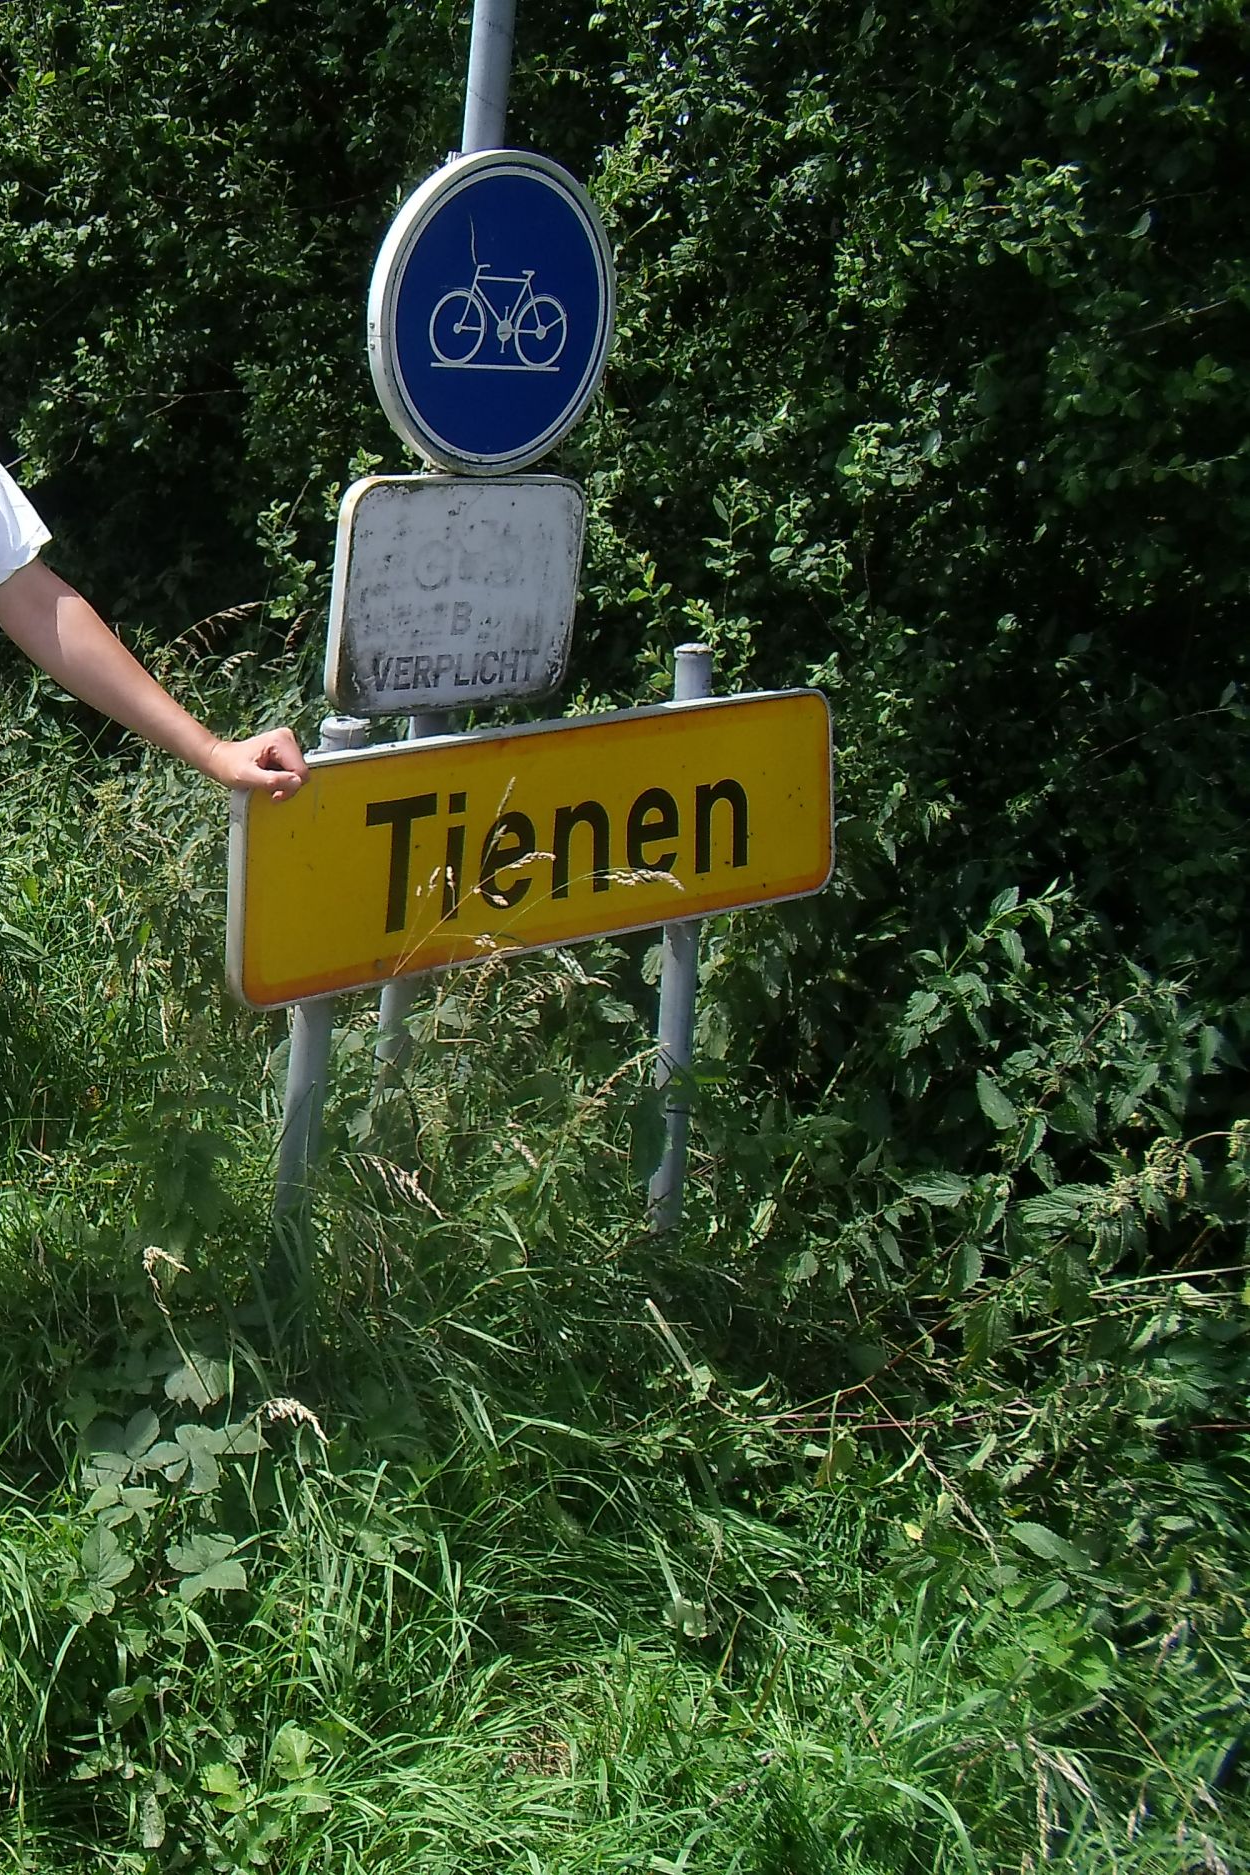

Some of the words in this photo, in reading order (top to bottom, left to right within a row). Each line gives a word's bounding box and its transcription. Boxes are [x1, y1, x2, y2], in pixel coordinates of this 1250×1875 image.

[450, 601, 473, 636] B
[370, 649, 539, 692] VERPLICHT
[366, 777, 749, 935] Tienen
